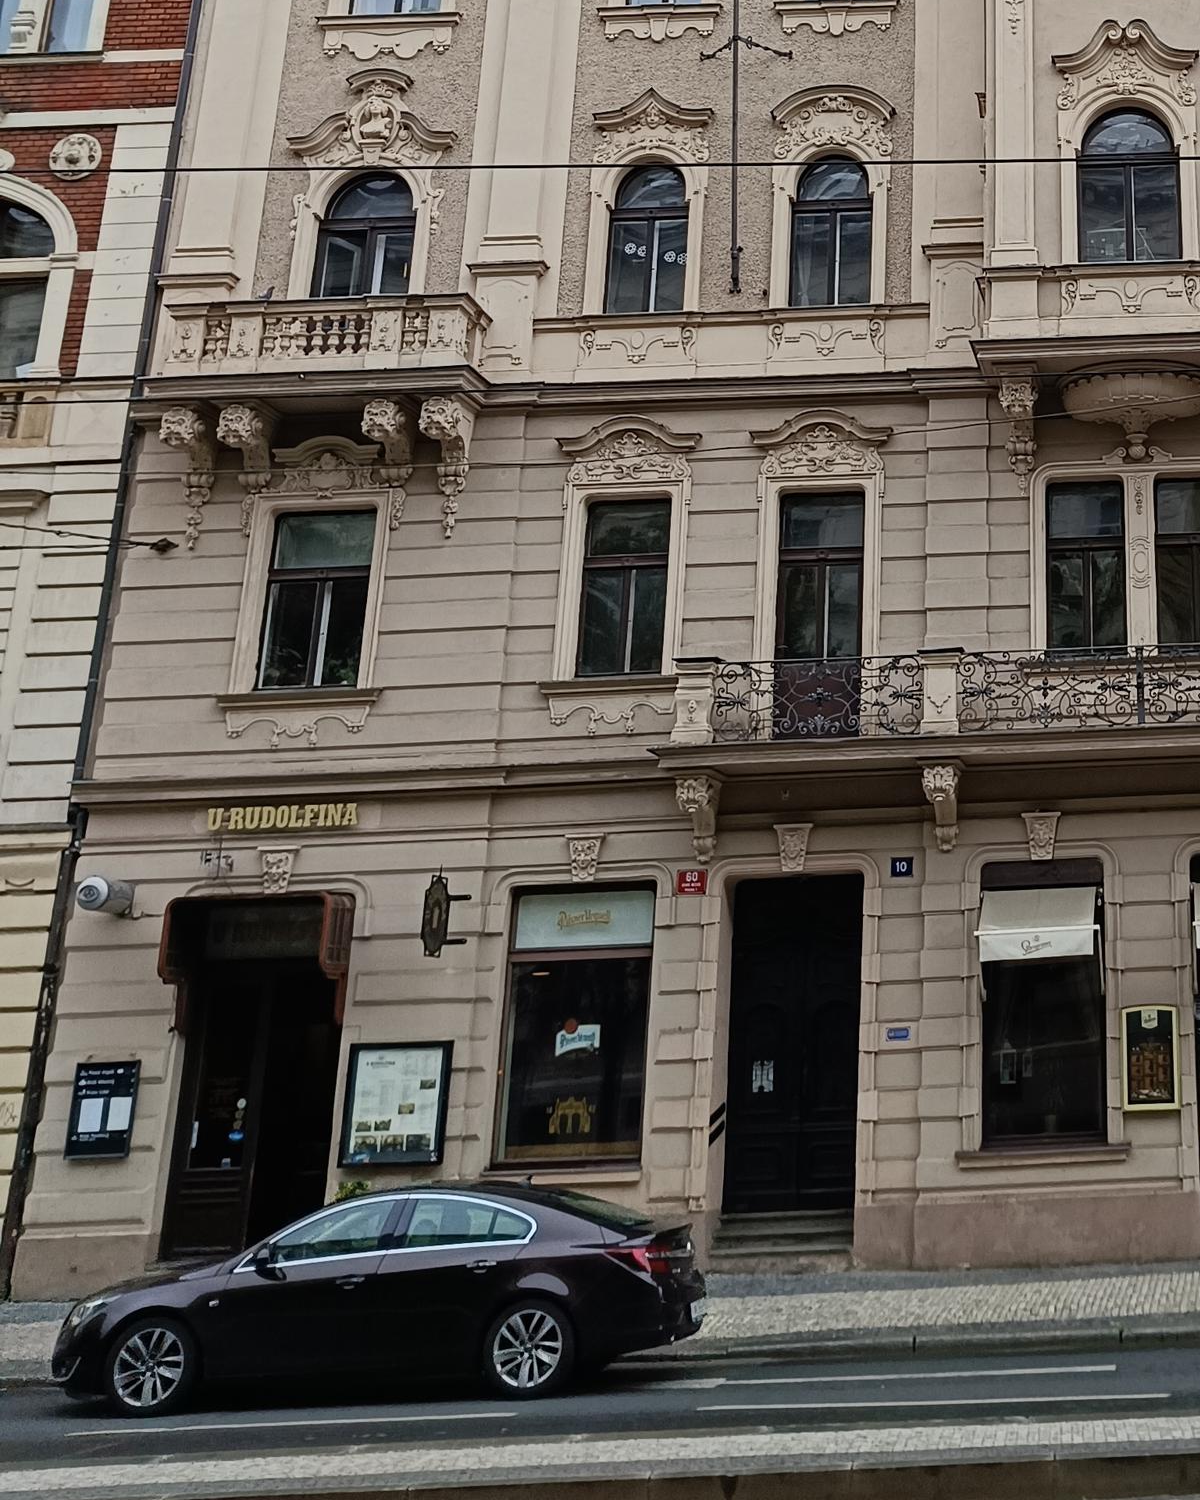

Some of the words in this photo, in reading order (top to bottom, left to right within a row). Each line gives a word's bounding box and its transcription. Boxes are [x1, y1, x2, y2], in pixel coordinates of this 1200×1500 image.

[207, 808, 225, 831] U
[228, 803, 358, 830] RUDOLFINA
[896, 861, 907, 872] 10
[686, 871, 698, 882] 60
